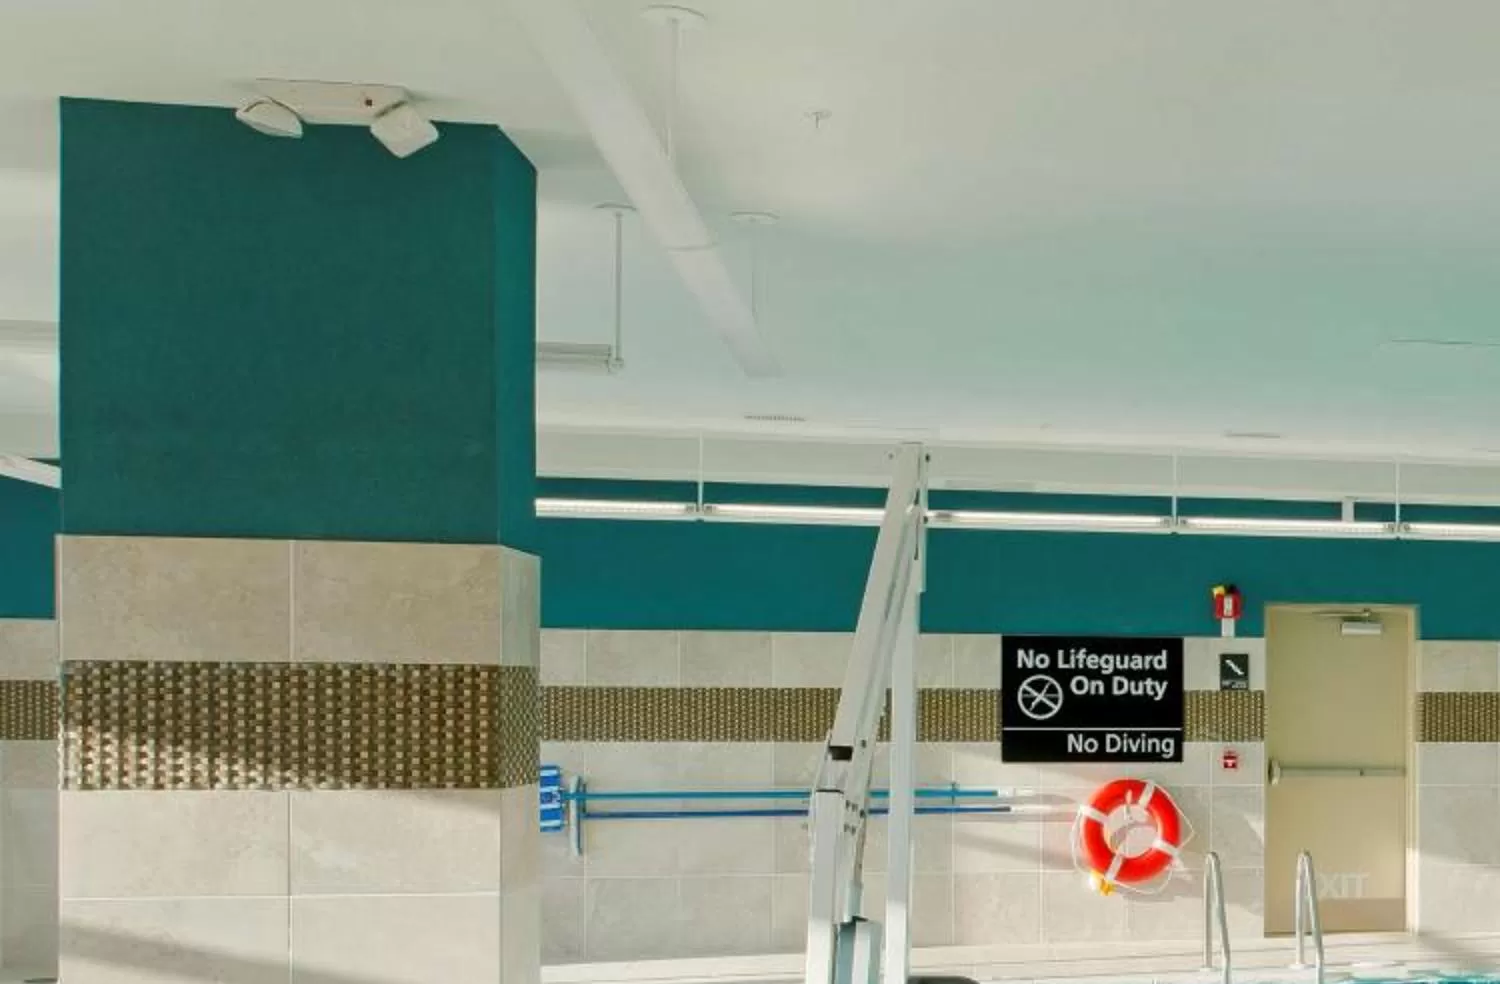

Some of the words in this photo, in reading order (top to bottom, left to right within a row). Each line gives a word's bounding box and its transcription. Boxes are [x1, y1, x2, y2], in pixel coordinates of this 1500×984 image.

[1016, 649, 1050, 669] No
[1057, 648, 1168, 675] Lifeguard
[1070, 675, 1105, 695] On
[1112, 676, 1168, 701] Duty
[1067, 733, 1099, 753] No
[1105, 733, 1175, 759] Diving
[1316, 871, 1370, 899] XIT
